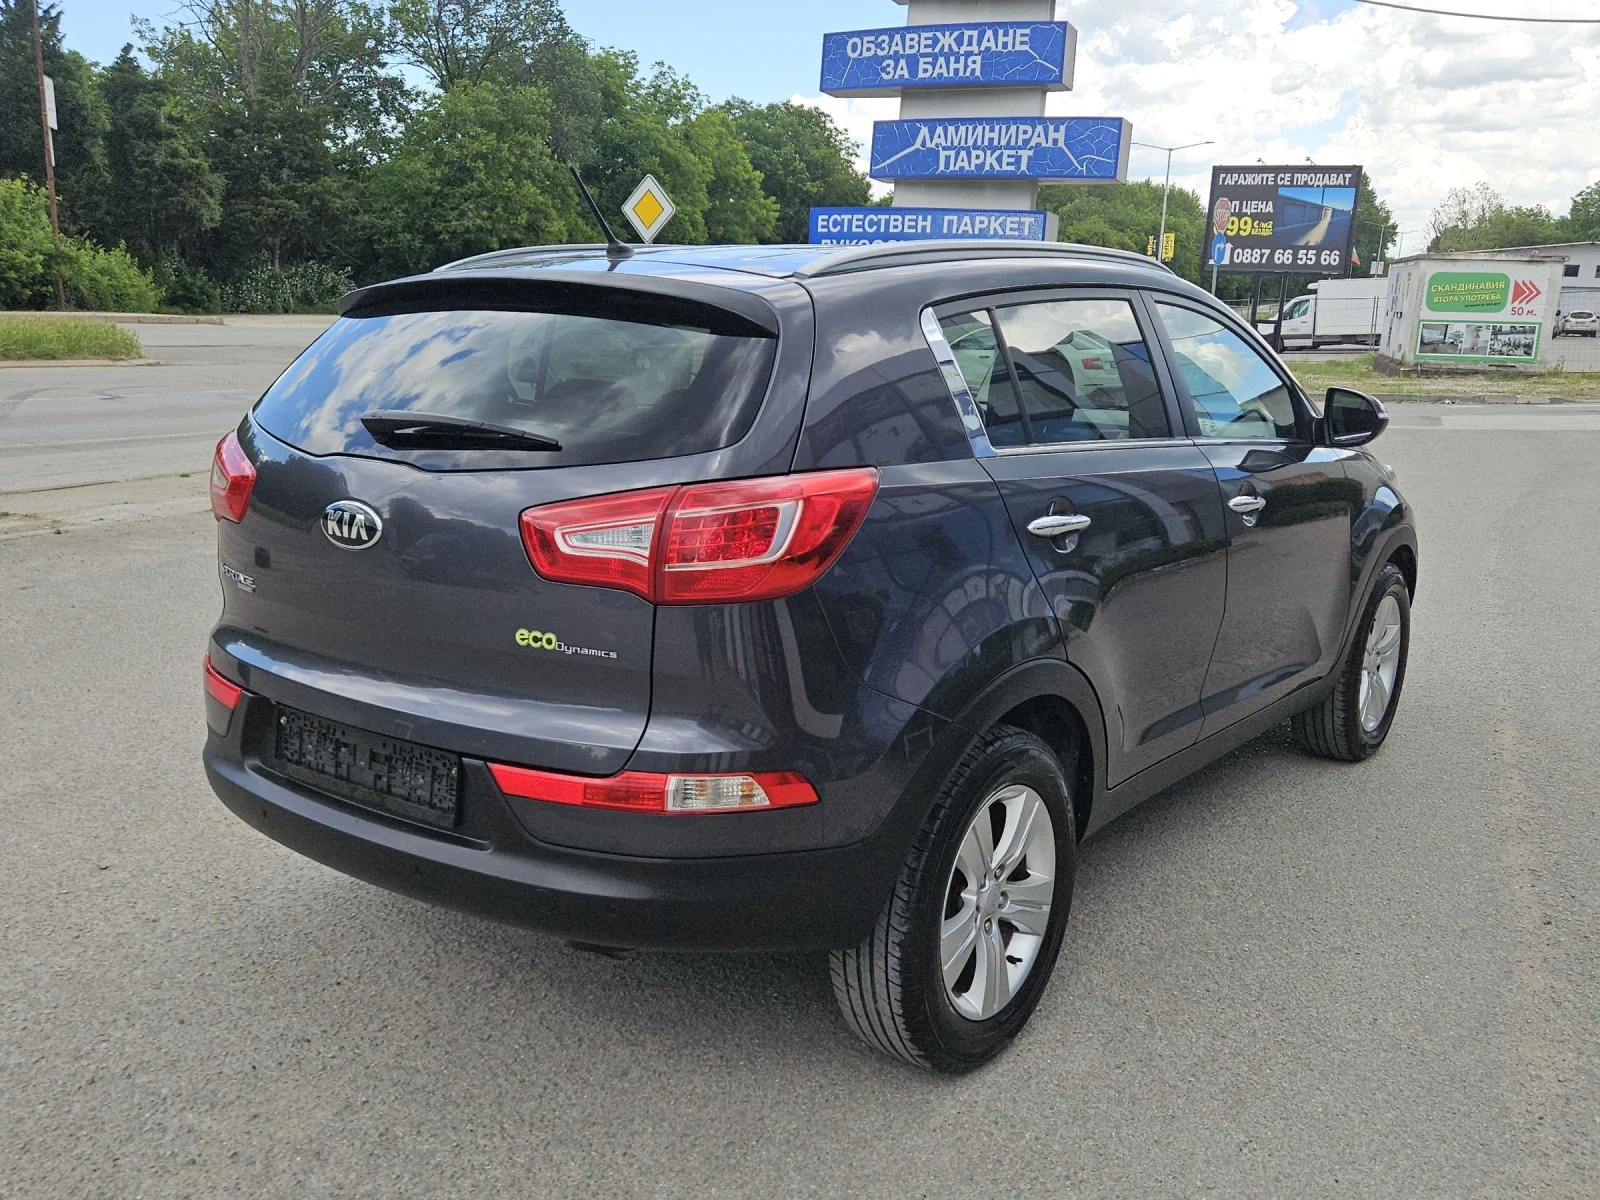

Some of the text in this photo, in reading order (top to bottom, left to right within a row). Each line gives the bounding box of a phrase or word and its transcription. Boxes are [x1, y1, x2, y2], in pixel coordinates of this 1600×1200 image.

[847, 28, 1030, 58] ОБЗАВЕЖДАНЕ
[881, 55, 982, 80] ЗА БАНЯ
[915, 124, 1065, 148] ЛАМИНИРАН
[939, 149, 1033, 171] ПАРКЕТ
[1219, 173, 1352, 187] ГАРАЖИТЕ СЕ ПРОДАВАТ
[1215, 208, 1229, 221] STOP
[1242, 200, 1274, 215] ЦЕНА
[817, 214, 1034, 236] ЕСТЕСТВЕН ПАРКЕТ
[1213, 216, 1253, 236] 99
[1233, 248, 1340, 266] 0887 66 55 66
[1431, 281, 1505, 293] СКАНДИНАВИЯ
[1433, 293, 1502, 304] ВТОРА УПОТРЕБА
[1511, 306, 1524, 316] 50
[327, 509, 369, 541] KIA
